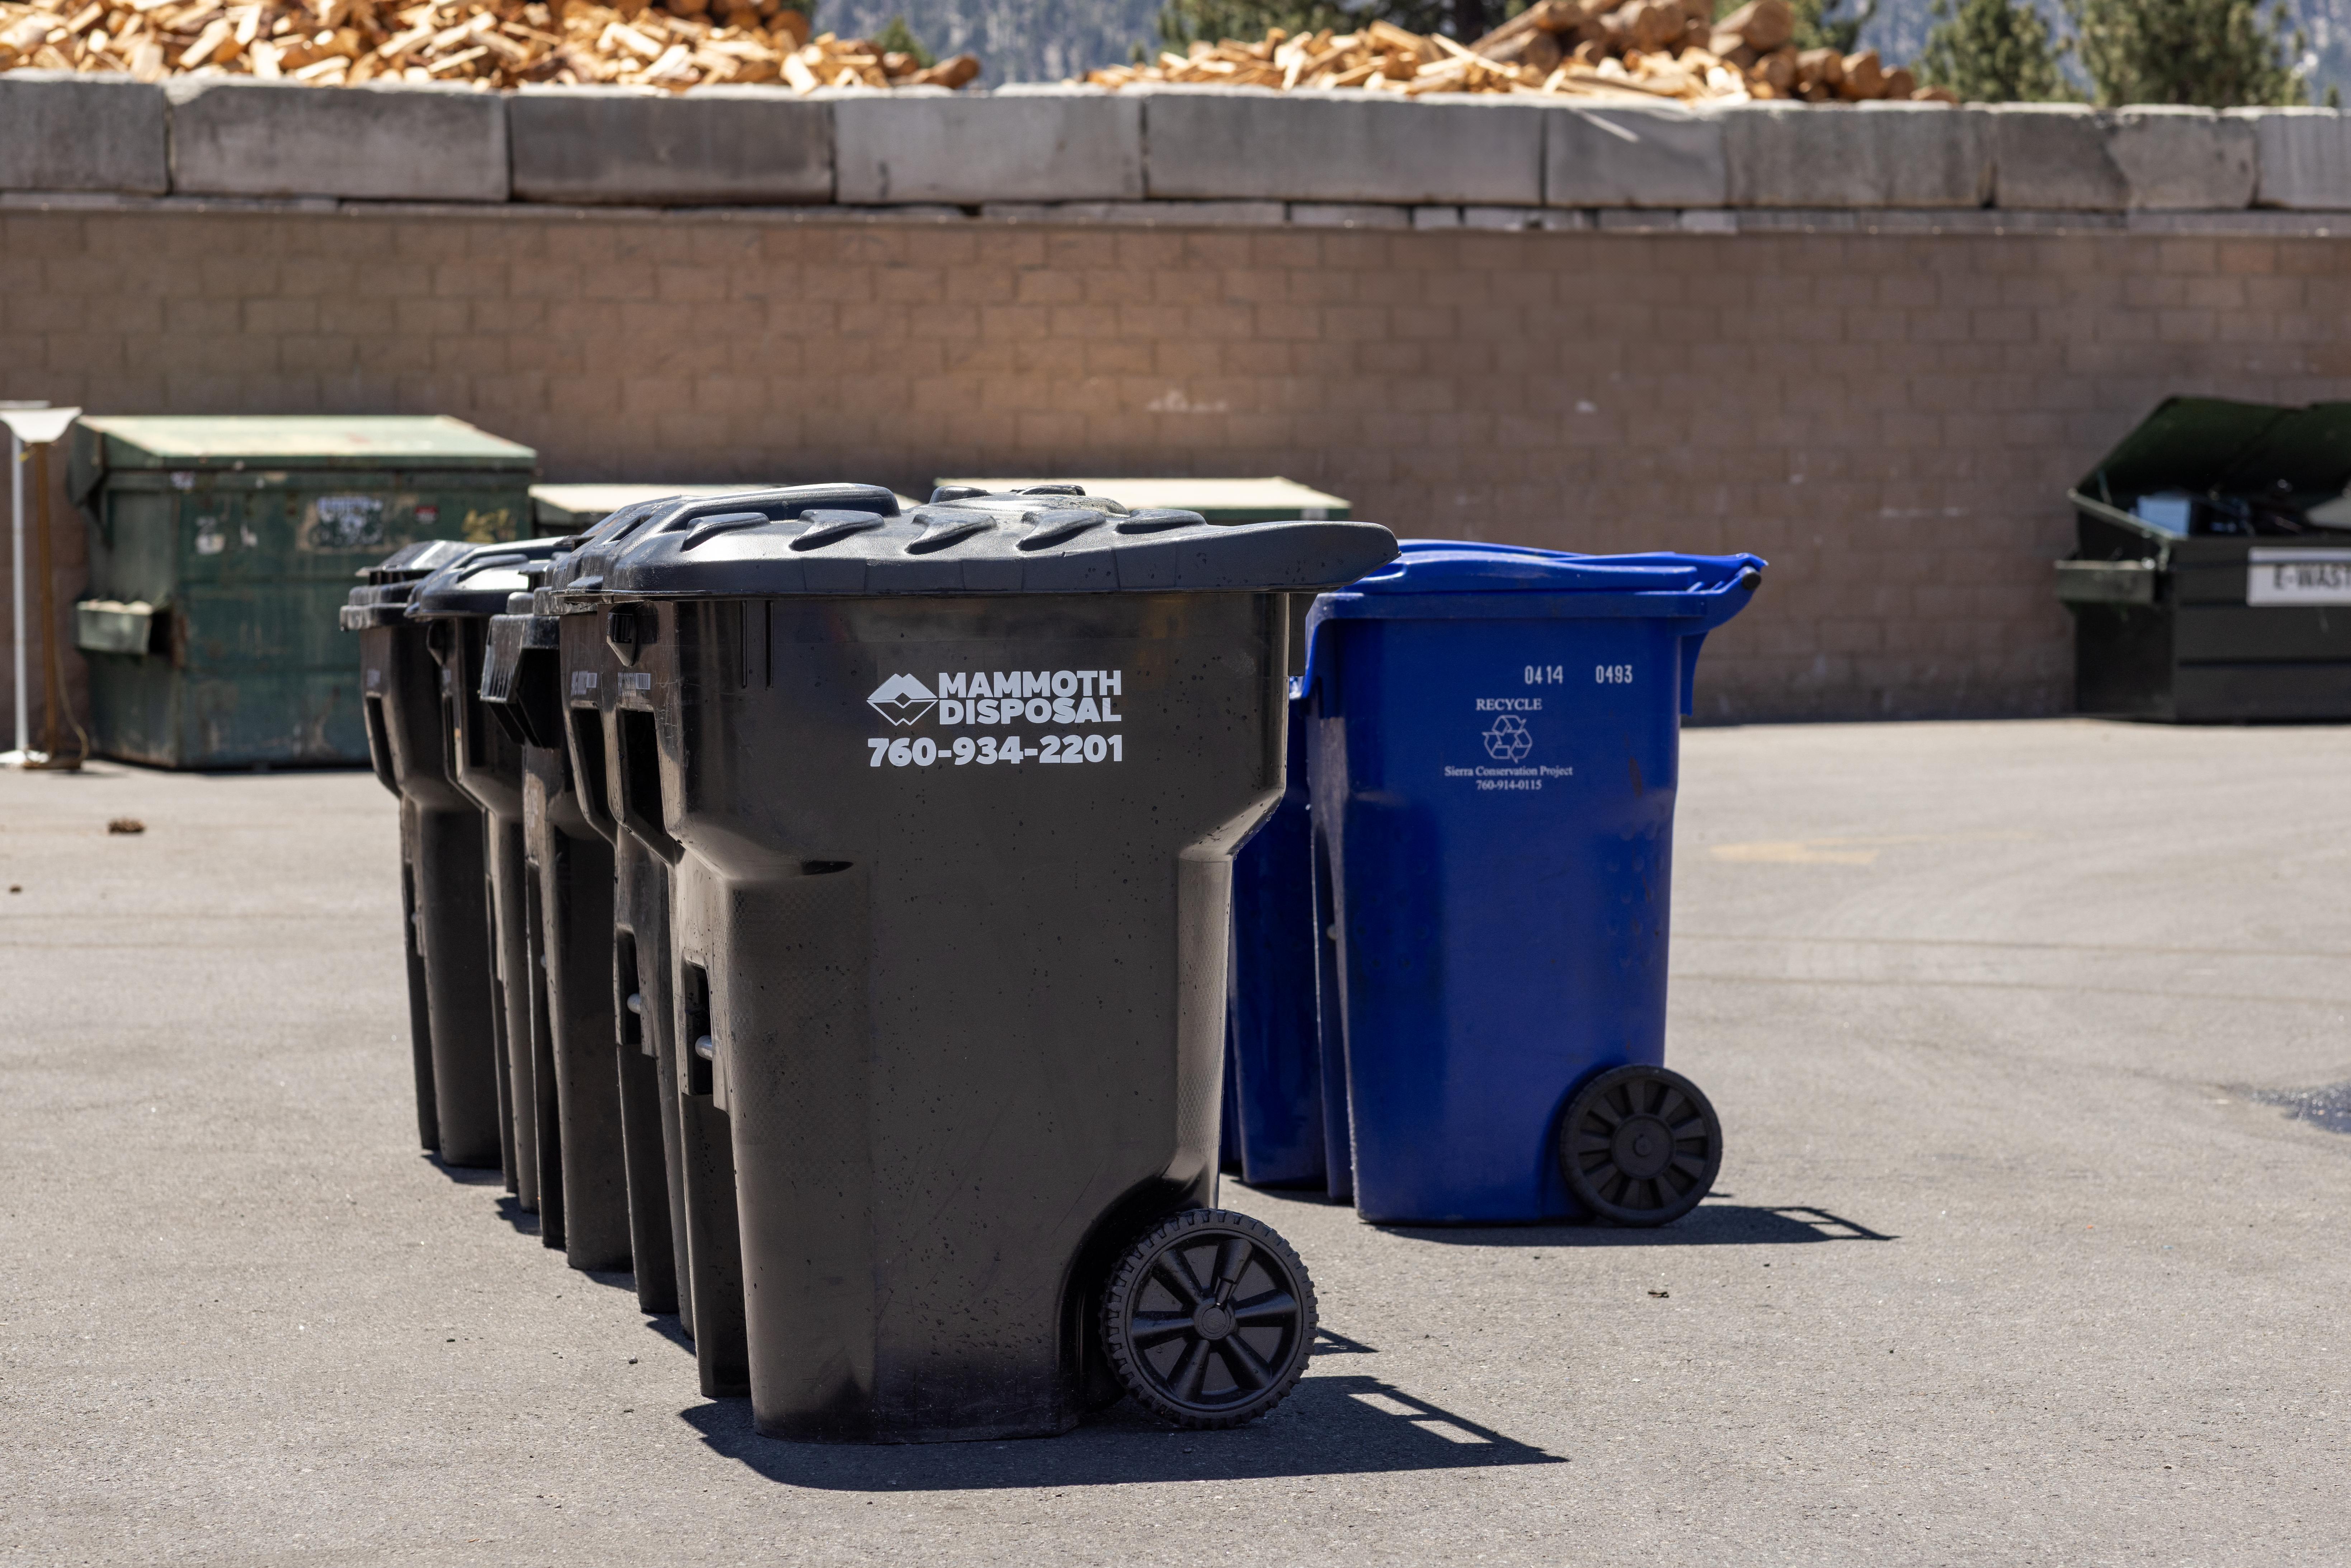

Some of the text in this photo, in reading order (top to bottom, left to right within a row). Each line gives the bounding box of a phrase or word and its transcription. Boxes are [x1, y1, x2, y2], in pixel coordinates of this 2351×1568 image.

[939, 670, 1121, 698] MAMMOTH
[1525, 665, 1632, 684] 0414 0493
[939, 697, 1122, 725] DISPOSAL
[1476, 698, 1542, 711] RECYCLE
[868, 734, 1122, 767] 760-934-2201
[1444, 765, 1573, 778] Sierra Conservation Project
[1476, 779, 1542, 790] 760-914-0115
